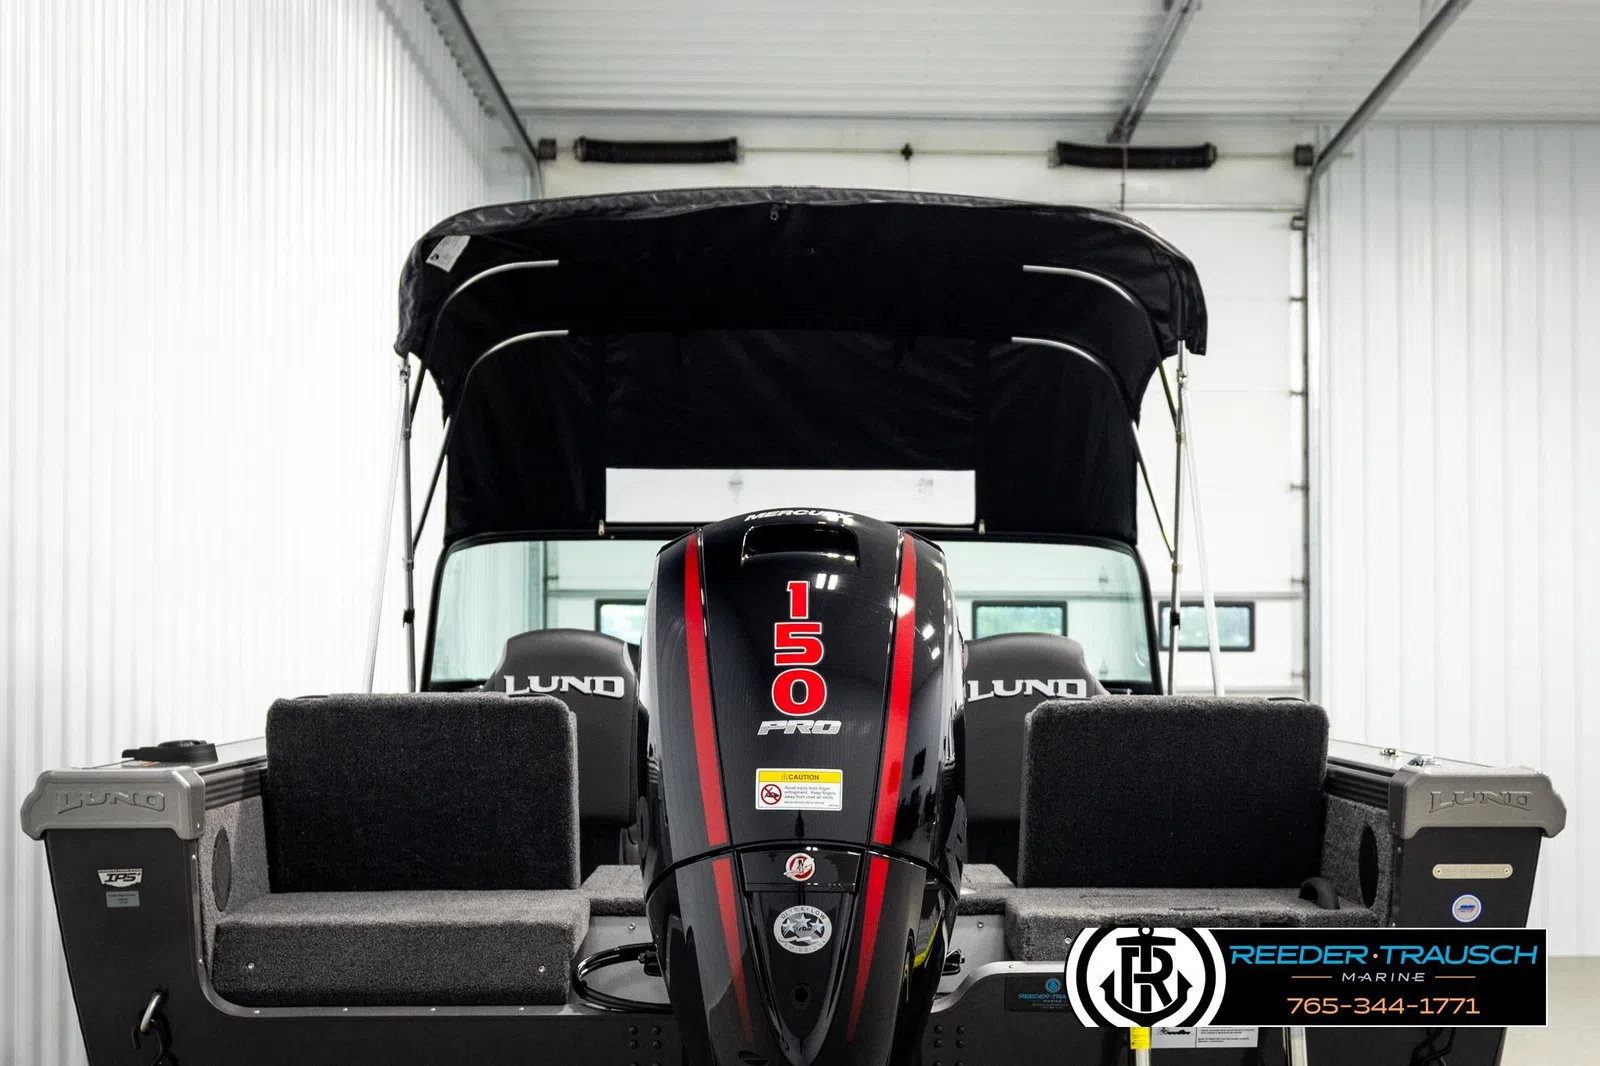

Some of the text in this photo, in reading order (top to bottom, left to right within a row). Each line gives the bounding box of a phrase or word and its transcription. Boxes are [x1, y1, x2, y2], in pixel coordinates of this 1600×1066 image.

[771, 580, 828, 717] 150
[503, 675, 625, 698] LUND
[967, 678, 1088, 702] LUND
[757, 719, 842, 735] PRO
[788, 773, 820, 781] CAUTION
[56, 790, 166, 814] LUND
[1430, 791, 1533, 813] LUND
